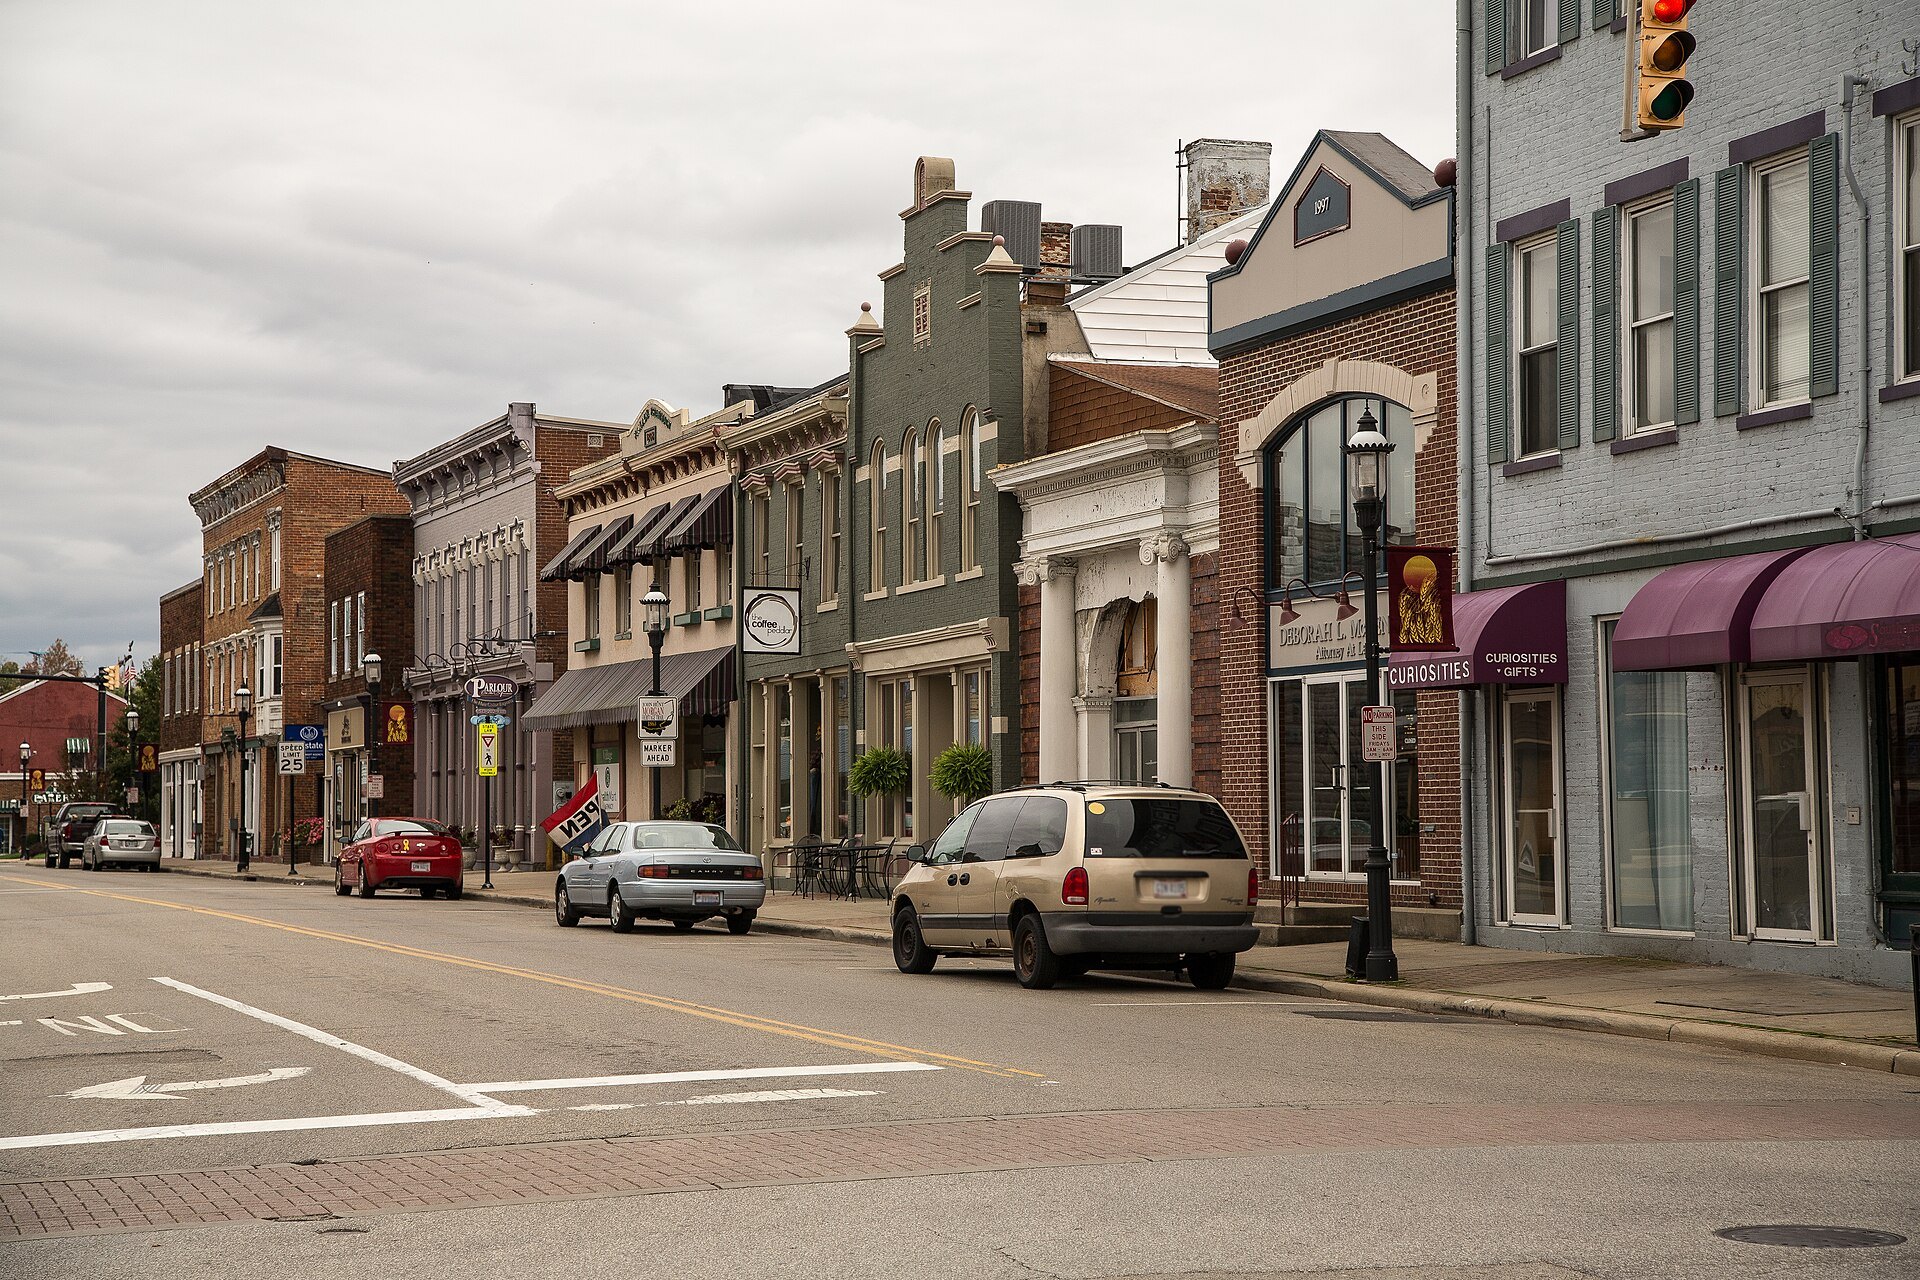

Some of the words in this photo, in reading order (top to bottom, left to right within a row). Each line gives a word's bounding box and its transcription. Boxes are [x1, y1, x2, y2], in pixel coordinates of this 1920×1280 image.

[752, 613, 762, 621] the
[752, 620, 777, 628] coffee
[1280, 622, 1333, 646] DEBORAH
[1316, 645, 1345, 661] Attorney
[1347, 643, 1356, 657] At
[1485, 653, 1558, 664] CURIOSITIES
[1390, 661, 1470, 684] CURIOSITIES
[1503, 667, 1537, 677] GIFTS
[642, 706, 665, 716] MORGAN
[1363, 710, 1373, 721] NO
[1374, 711, 1393, 719] PARKING
[643, 744, 673, 753] MARKER
[646, 754, 670, 762] AHEAD
[281, 758, 303, 771] 25
